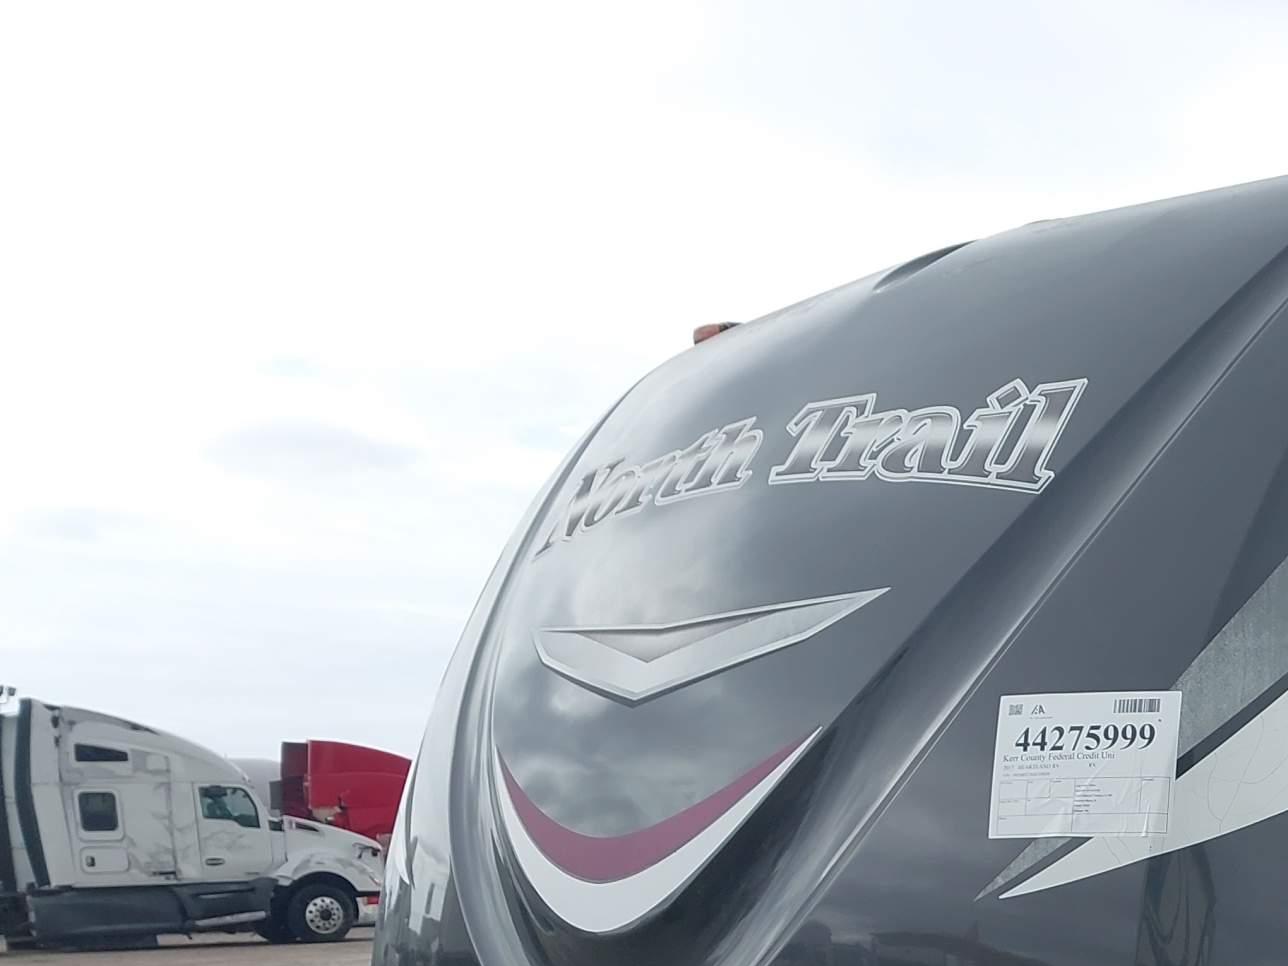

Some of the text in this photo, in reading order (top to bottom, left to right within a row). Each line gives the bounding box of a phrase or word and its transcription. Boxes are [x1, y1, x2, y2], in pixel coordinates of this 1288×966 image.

[533, 377, 1088, 563] North Trail
[1015, 723, 1156, 752] 44275999
[1003, 754, 1019, 762] Kerr
[1021, 753, 1046, 763] County
[1048, 752, 1075, 761] Federal
[1077, 751, 1099, 760] Credit
